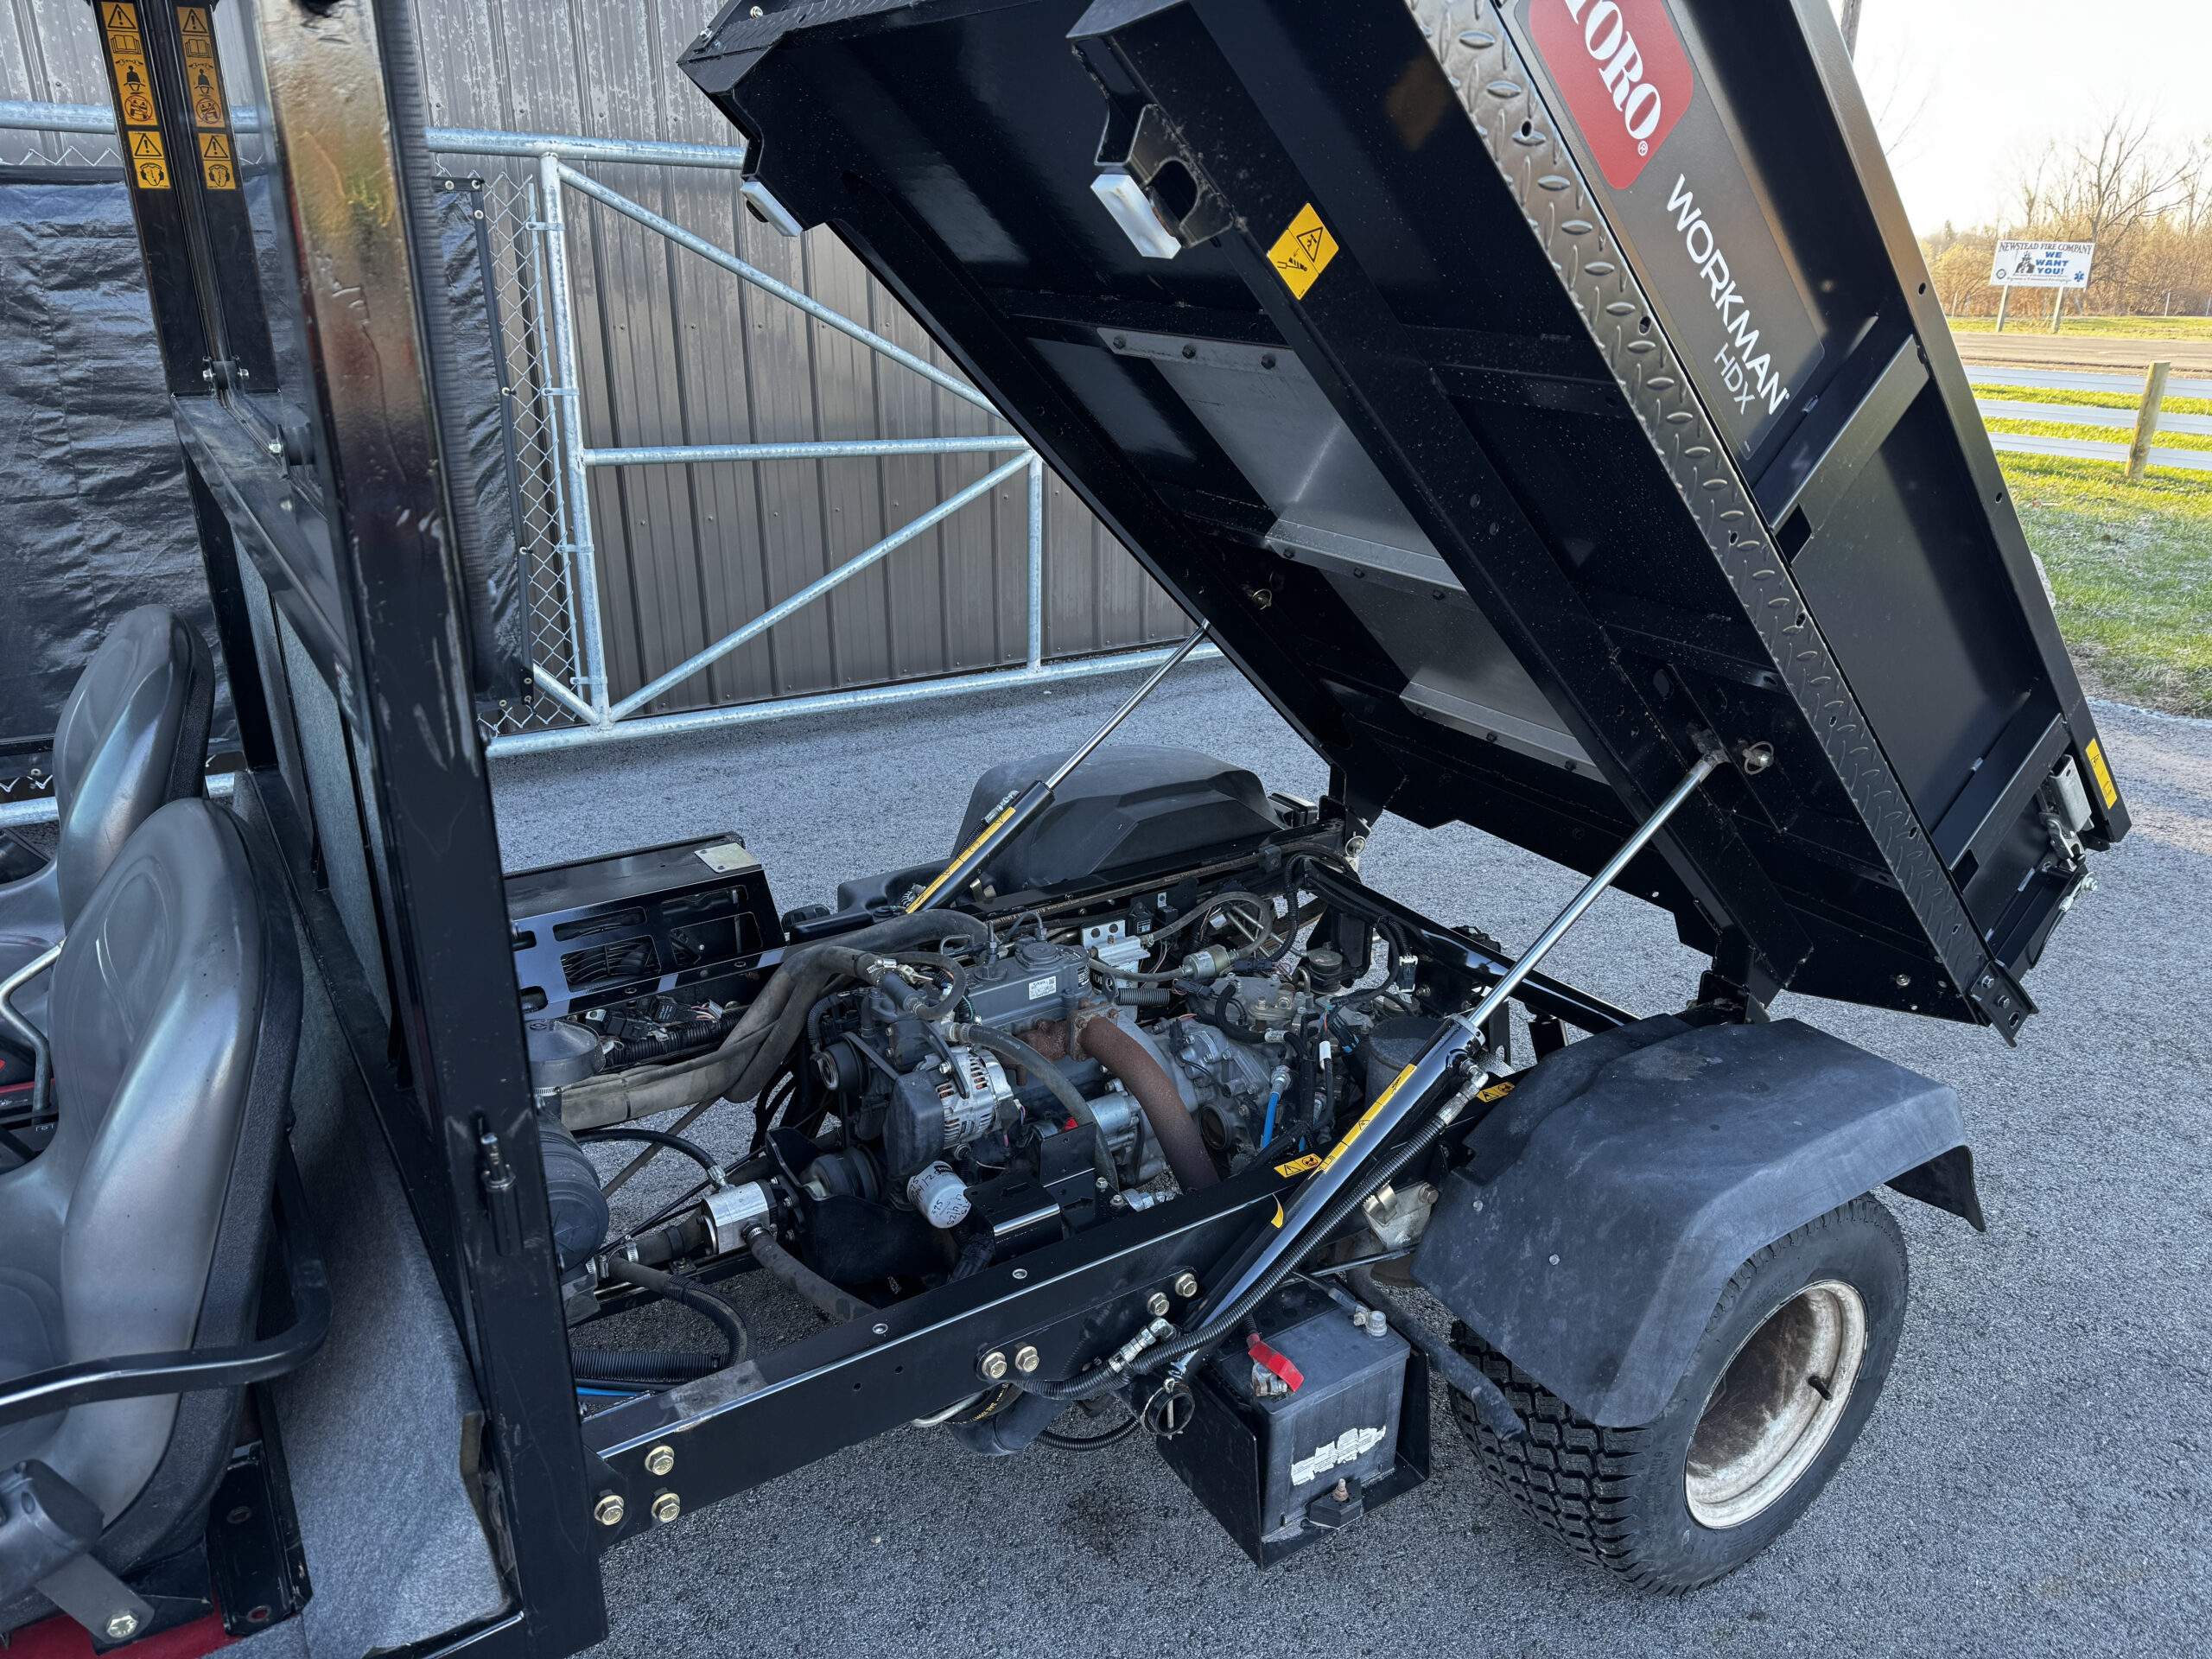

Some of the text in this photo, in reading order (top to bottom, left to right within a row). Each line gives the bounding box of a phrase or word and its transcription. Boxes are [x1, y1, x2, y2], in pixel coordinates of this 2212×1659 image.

[1999, 242, 2038, 251] NEWSTEAD
[2057, 243, 2092, 254] COMPANY
[1667, 174, 1788, 415] WORKMAN
[1713, 342, 1755, 415] HDX
